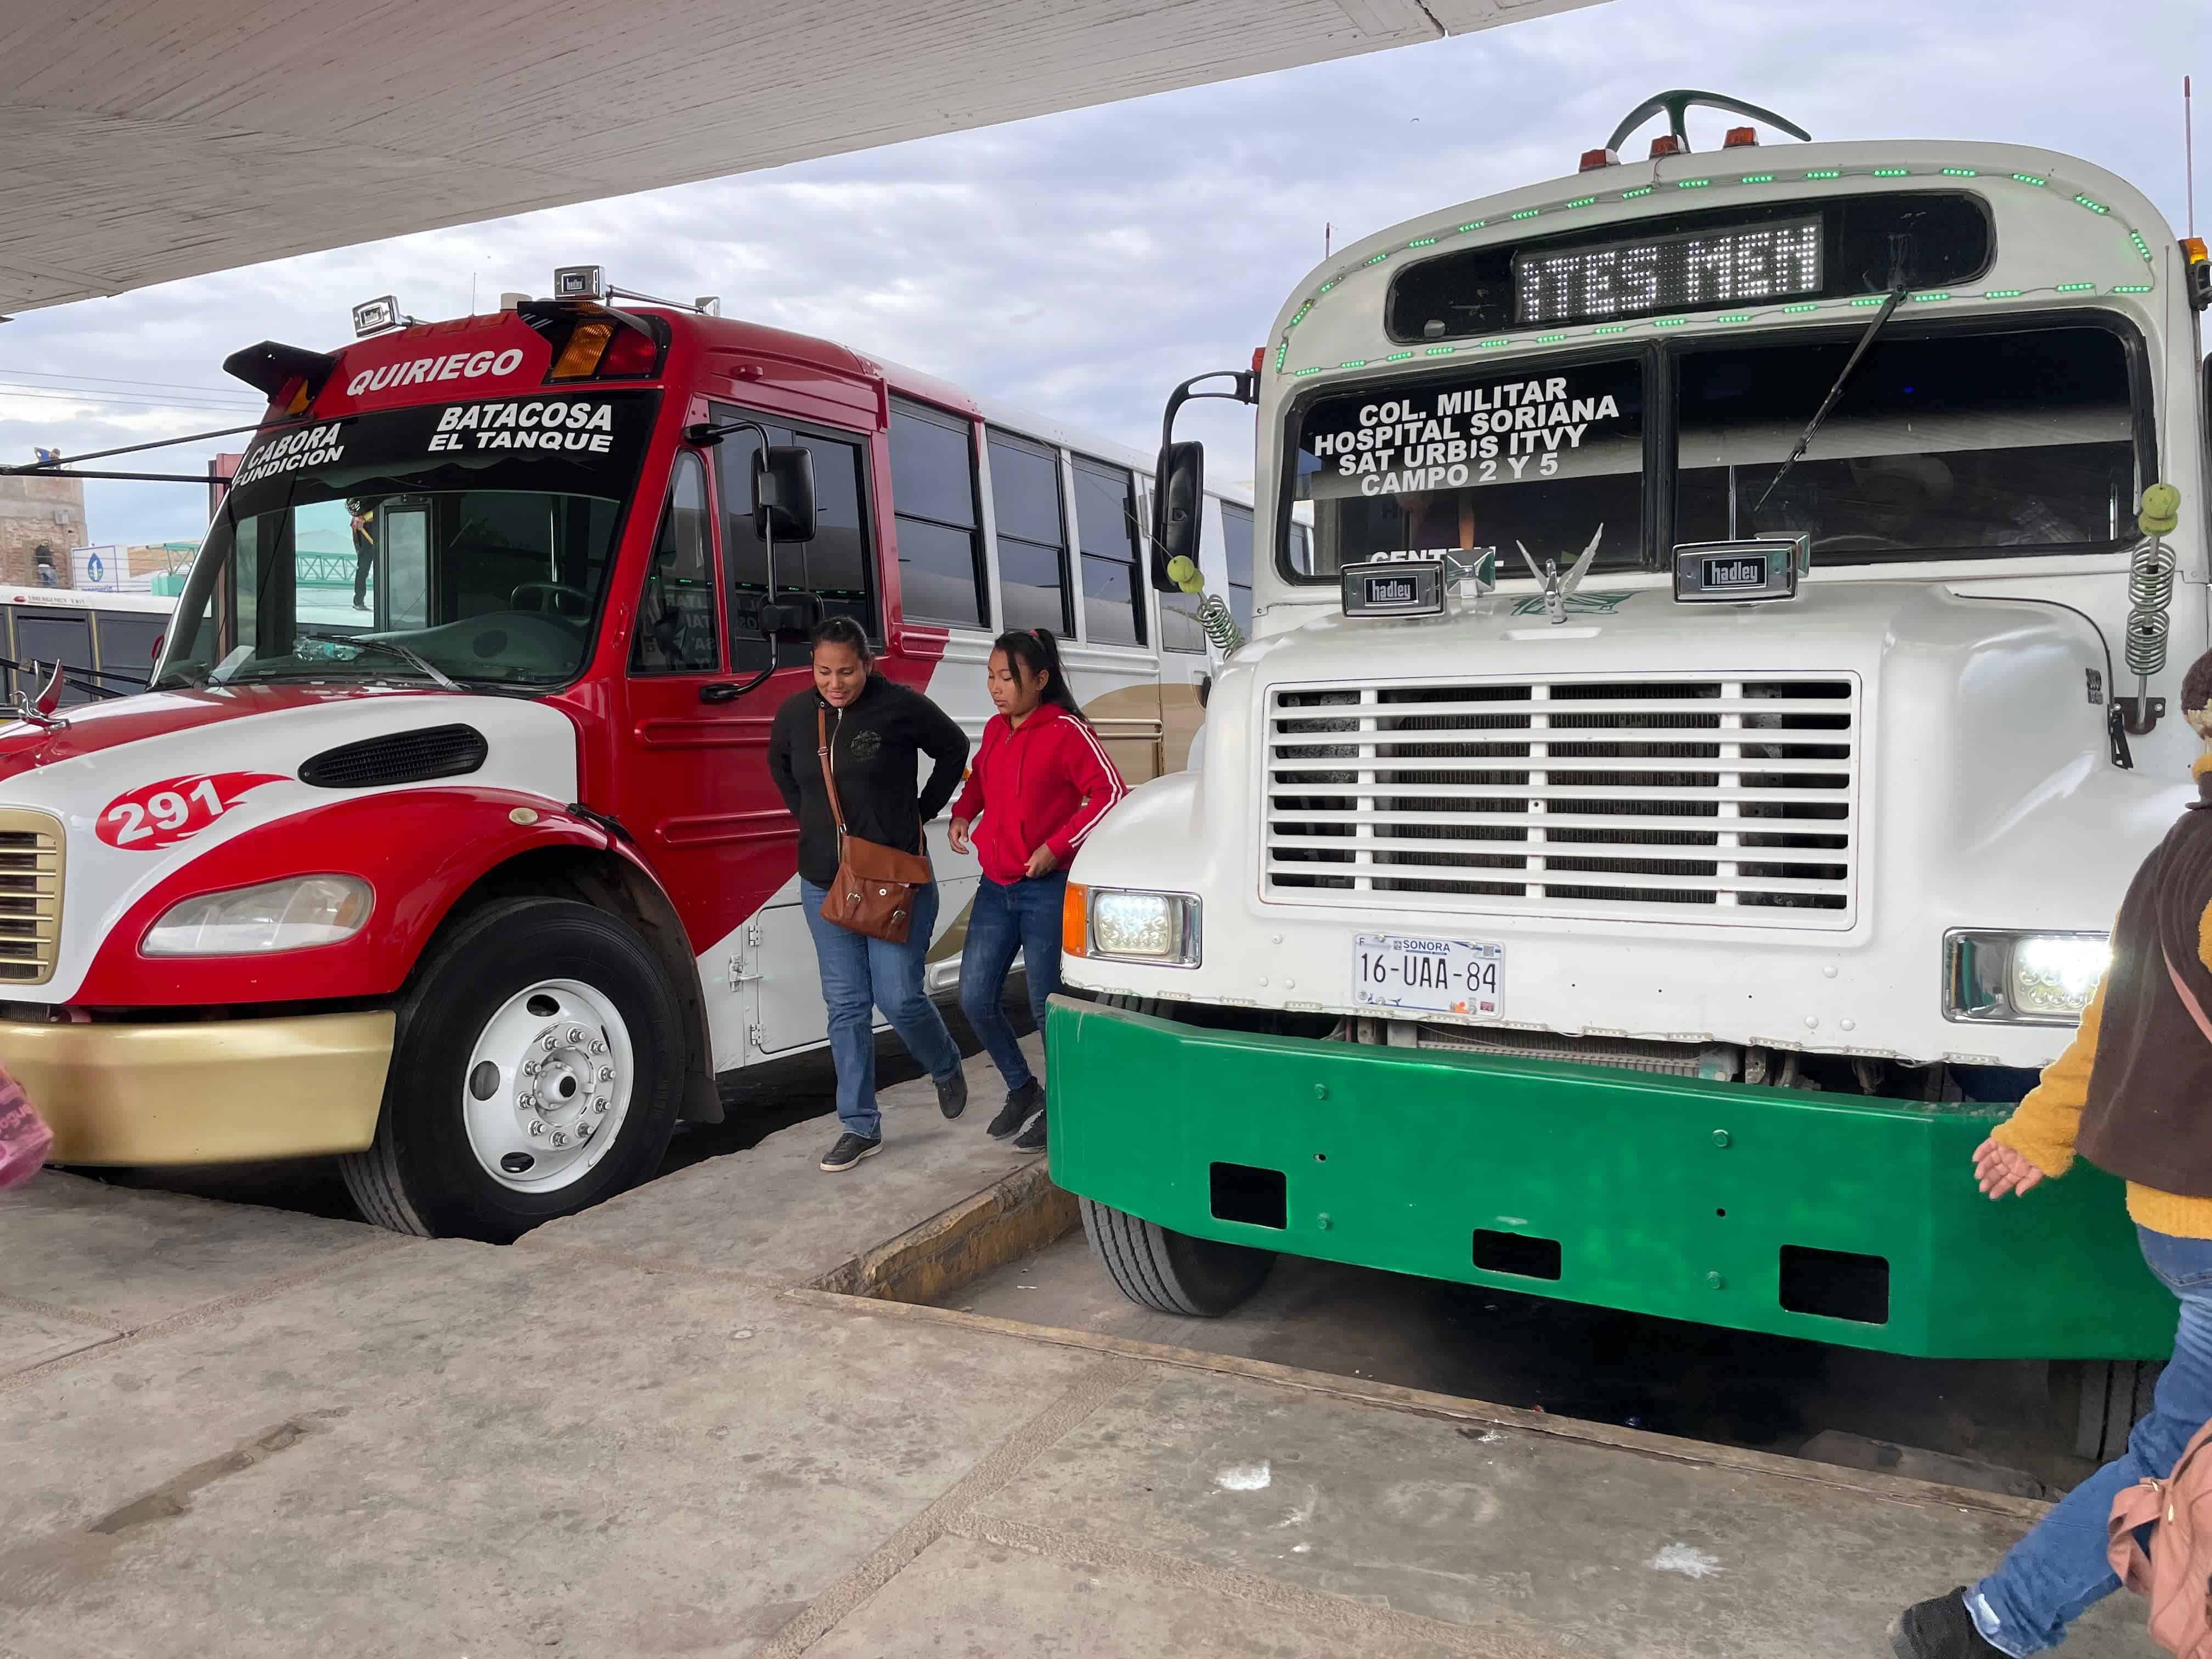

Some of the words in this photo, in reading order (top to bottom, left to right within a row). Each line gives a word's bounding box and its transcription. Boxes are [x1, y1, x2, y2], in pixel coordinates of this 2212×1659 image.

[346, 349, 524, 397] QUIRIEGO
[436, 402, 611, 431] BATACOSA
[1359, 400, 1427, 427] COL.
[1437, 376, 1567, 416] MILITAR
[247, 422, 342, 470] CABORA
[428, 433, 464, 452] EL
[476, 431, 613, 453] TANQUE
[1314, 416, 1462, 457] HOSPITAL
[1470, 395, 1620, 436] SORIANA
[232, 445, 345, 490] FUNDICION
[1338, 448, 1398, 477] SAT
[1403, 435, 1499, 467] URBIS
[1510, 424, 1588, 455] ITVY
[1361, 462, 1469, 497] CAMPO
[1479, 460, 1497, 483] 2
[1509, 455, 1531, 480] Y
[1539, 453, 1559, 476] 5
[1372, 580, 1412, 602] hadley
[1712, 561, 1758, 585] hadley
[108, 780, 224, 845] 291
[1403, 940, 1451, 953] SONORA
[1361, 952, 1496, 994] 16-UAA-84
